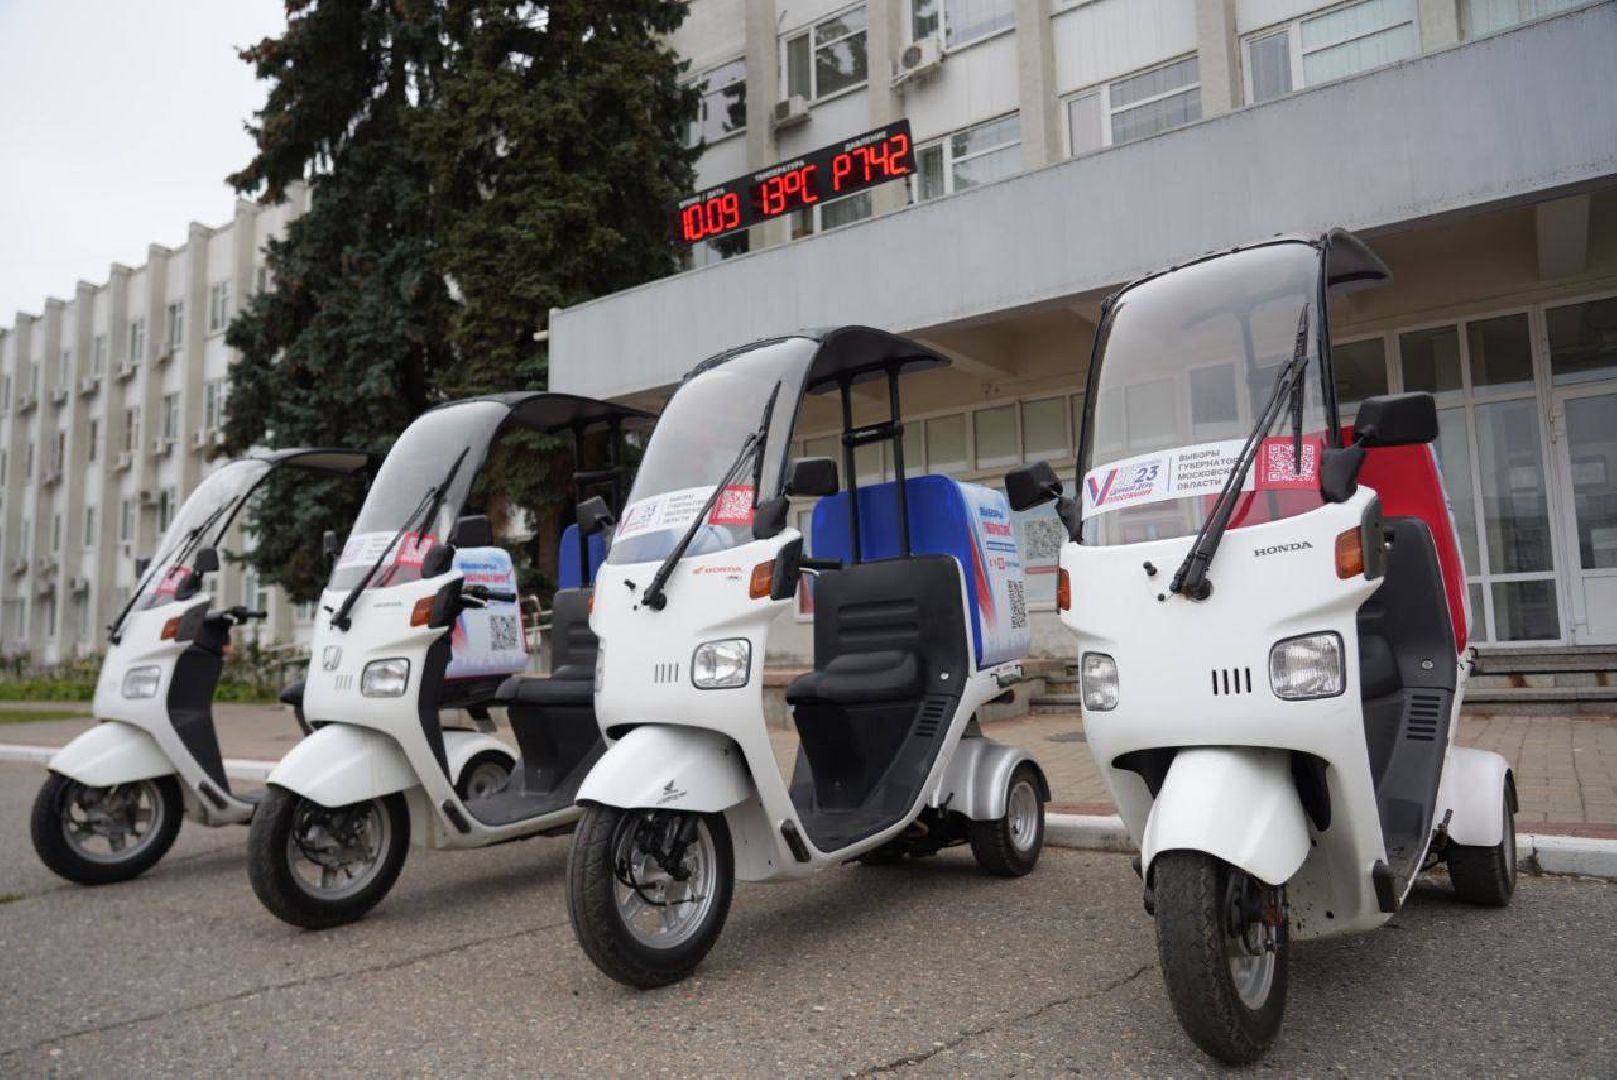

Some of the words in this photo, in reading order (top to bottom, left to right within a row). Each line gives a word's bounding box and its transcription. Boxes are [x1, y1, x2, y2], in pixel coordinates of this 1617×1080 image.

[682, 192, 741, 240] 10.09
[1178, 449, 1221, 462] ВЫБОРЫ
[1177, 457, 1240, 471] ГУБЕРНАТОР
[1134, 465, 1160, 483] 23
[1177, 467, 1233, 481] МОСКОВСК
[1177, 479, 1222, 491] ОБЛАСТИ
[1254, 540, 1313, 558] HONDA
